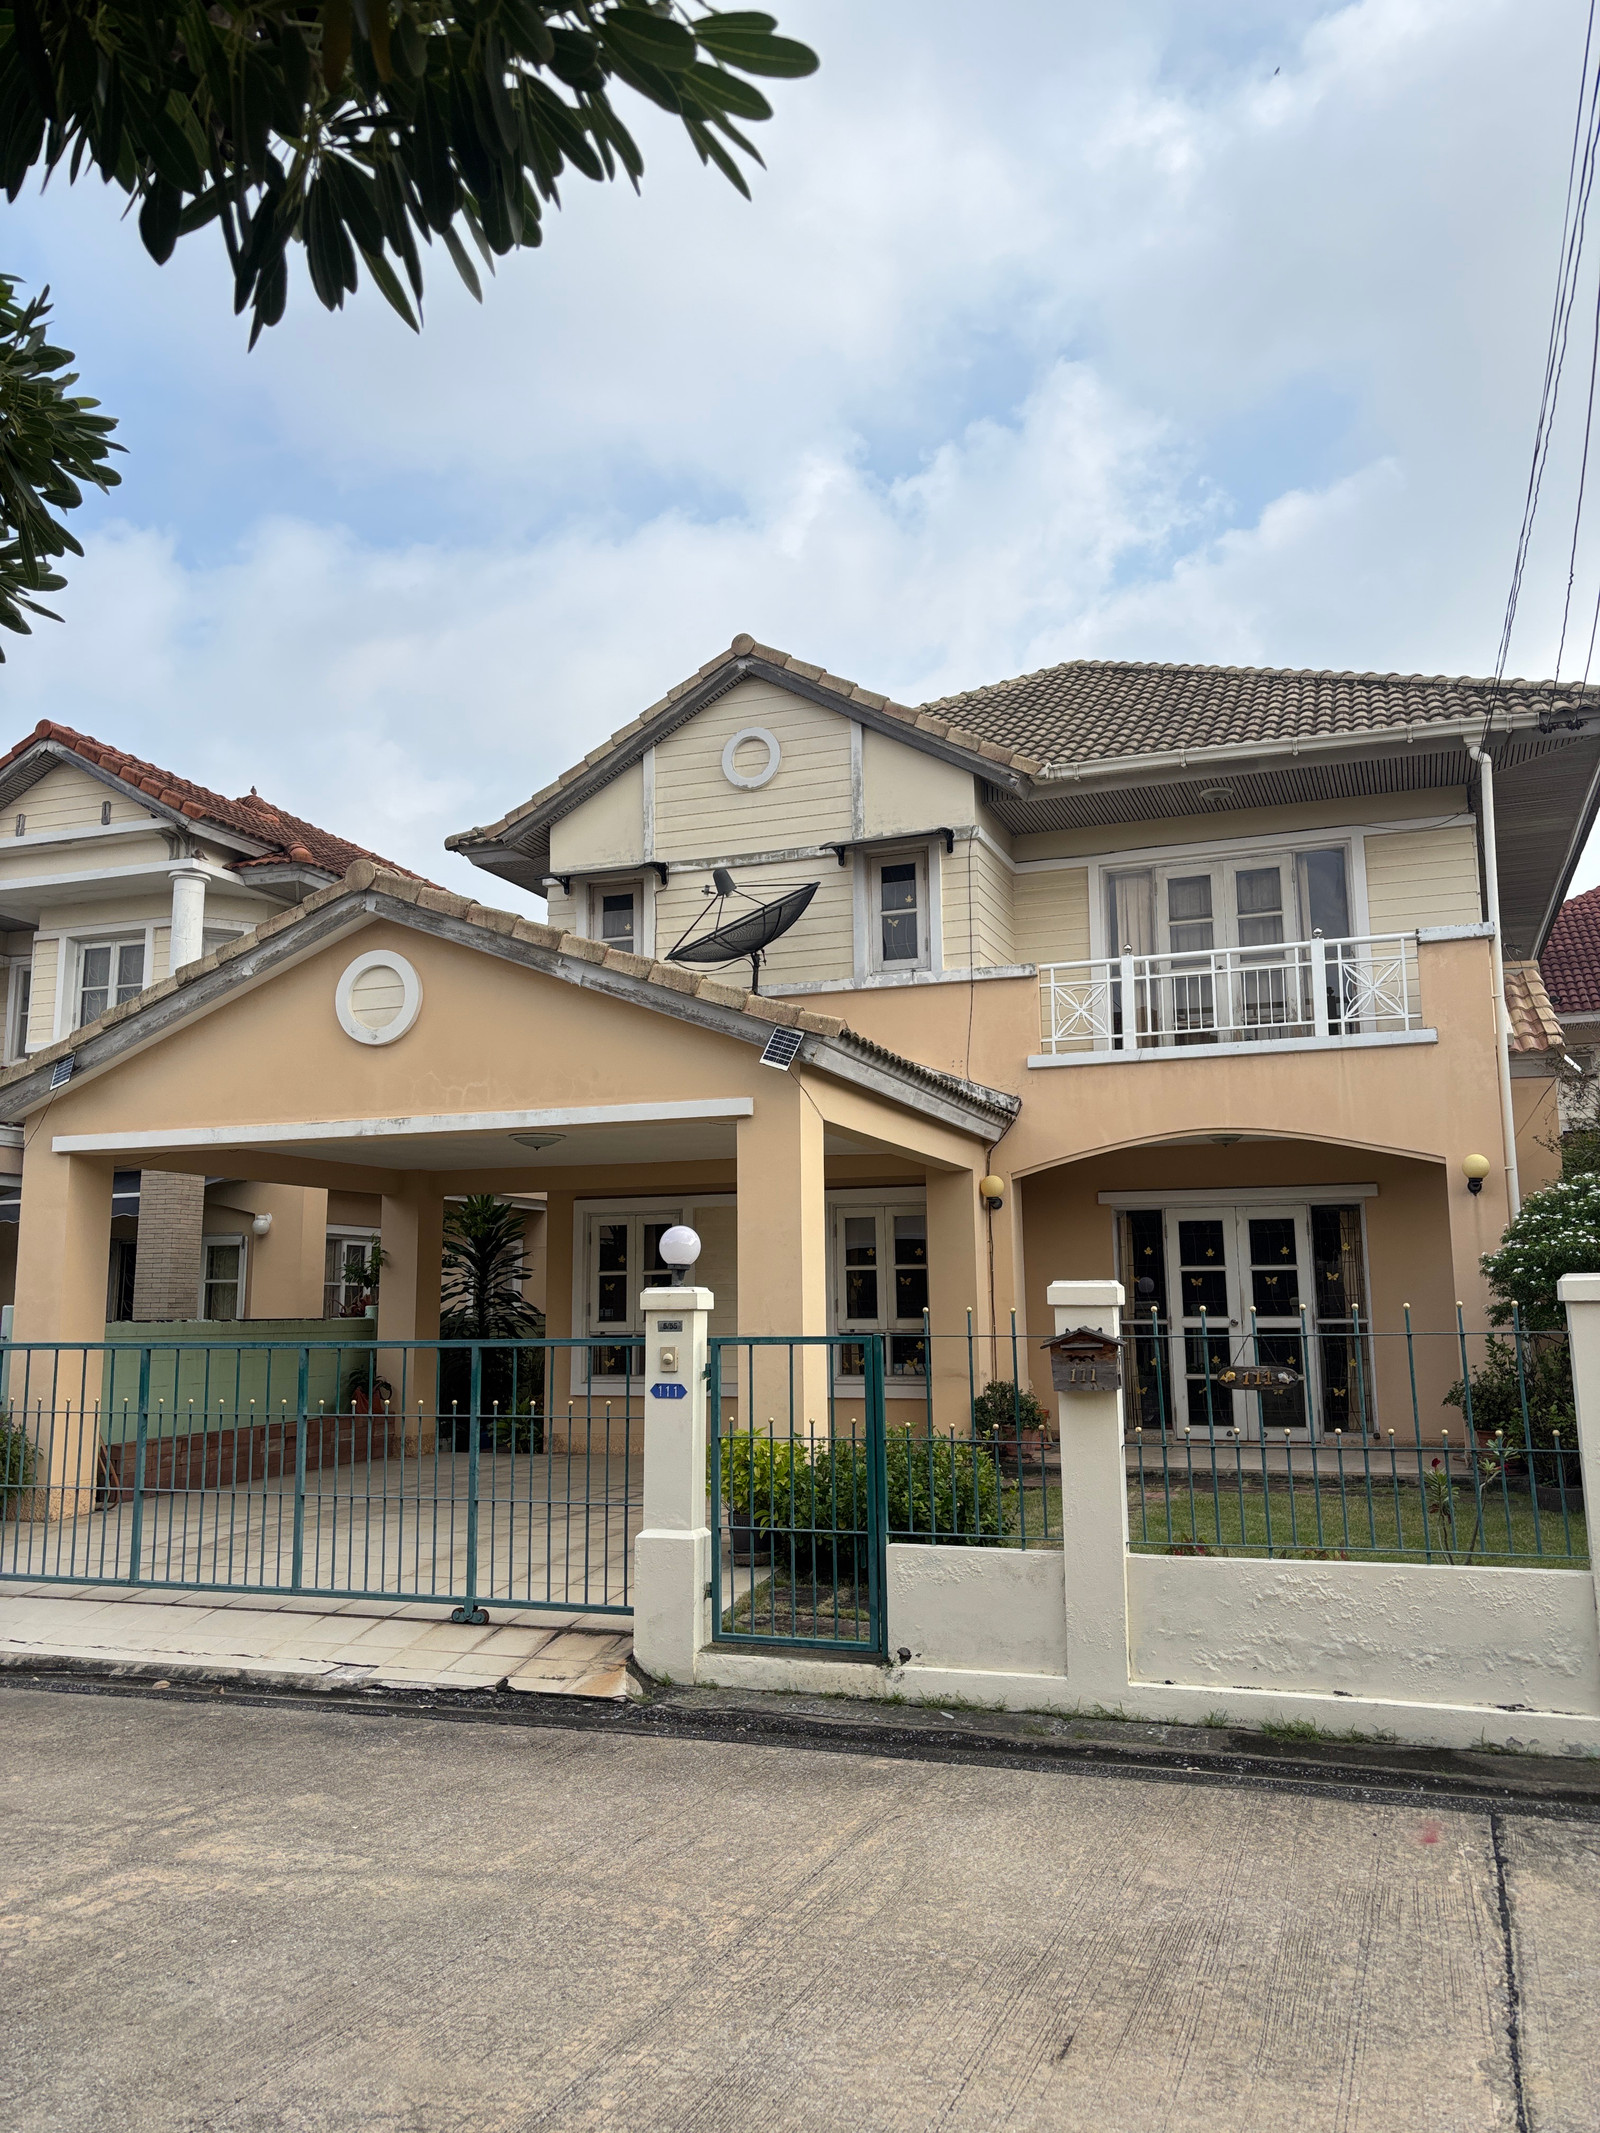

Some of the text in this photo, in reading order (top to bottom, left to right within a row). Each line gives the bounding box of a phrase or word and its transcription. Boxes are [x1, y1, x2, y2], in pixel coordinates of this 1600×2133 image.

[1069, 1368, 1096, 1381] 111
[1242, 1371, 1272, 1385] 111
[658, 1385, 677, 1397] 111
